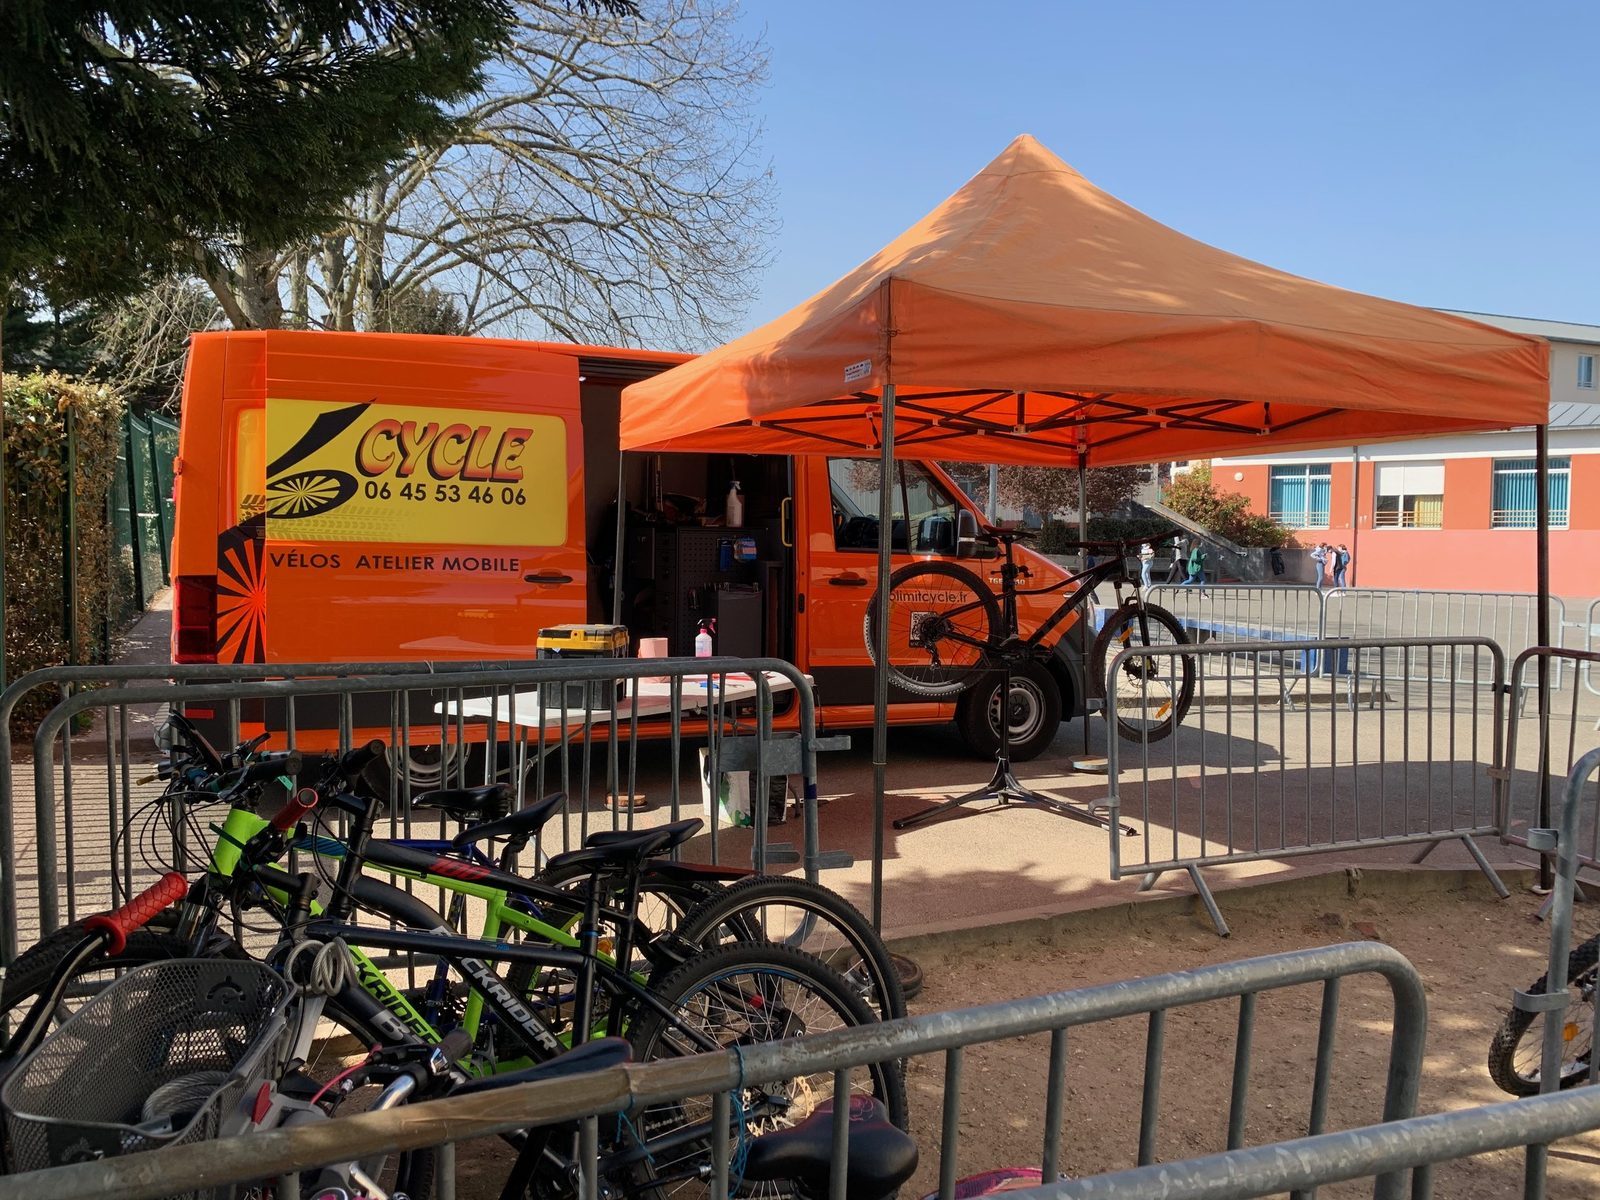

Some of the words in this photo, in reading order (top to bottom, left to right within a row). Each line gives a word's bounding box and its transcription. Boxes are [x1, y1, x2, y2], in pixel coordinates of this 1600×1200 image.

[355, 418, 534, 483] CYCLE
[364, 480, 392, 500] 06
[399, 482, 427, 502] 45
[434, 484, 461, 503] 53
[468, 485, 494, 504] 46
[501, 487, 527, 506] 06
[270, 550, 341, 569] VÉLOS
[355, 555, 435, 571] ATELIER
[442, 557, 520, 573] MOBILE
[889, 590, 968, 605] olimitcycle.fr
